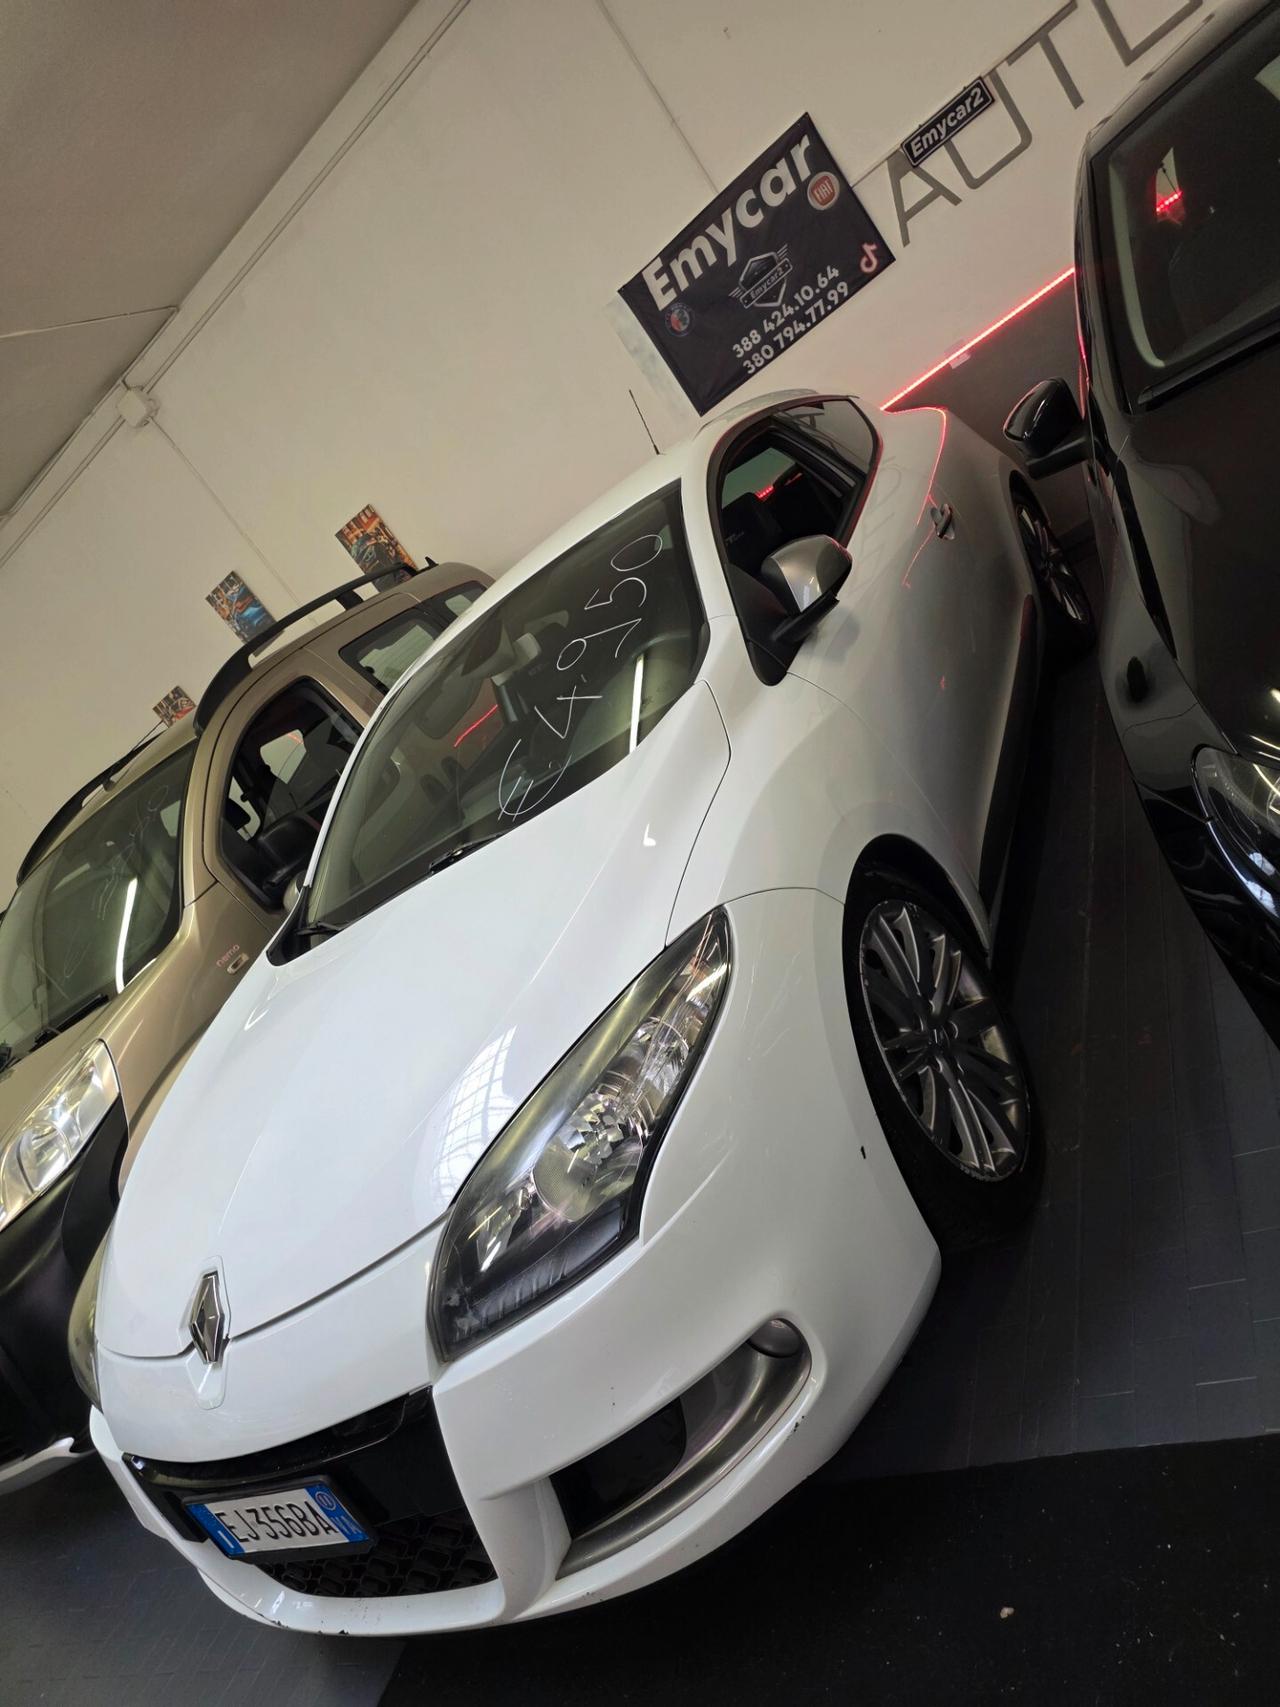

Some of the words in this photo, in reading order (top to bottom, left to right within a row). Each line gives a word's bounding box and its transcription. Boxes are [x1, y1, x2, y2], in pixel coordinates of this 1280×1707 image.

[910, 87, 983, 158] Emycar2
[642, 134, 811, 312] Emycar
[813, 180, 833, 202] FIAT
[732, 329, 761, 358] 388
[763, 265, 839, 334] 424.10.64
[749, 266, 784, 299] Emycar2
[743, 344, 774, 374] 380
[773, 281, 848, 349] 794.77.99
[215, 1501, 338, 1543] EJ356BA
